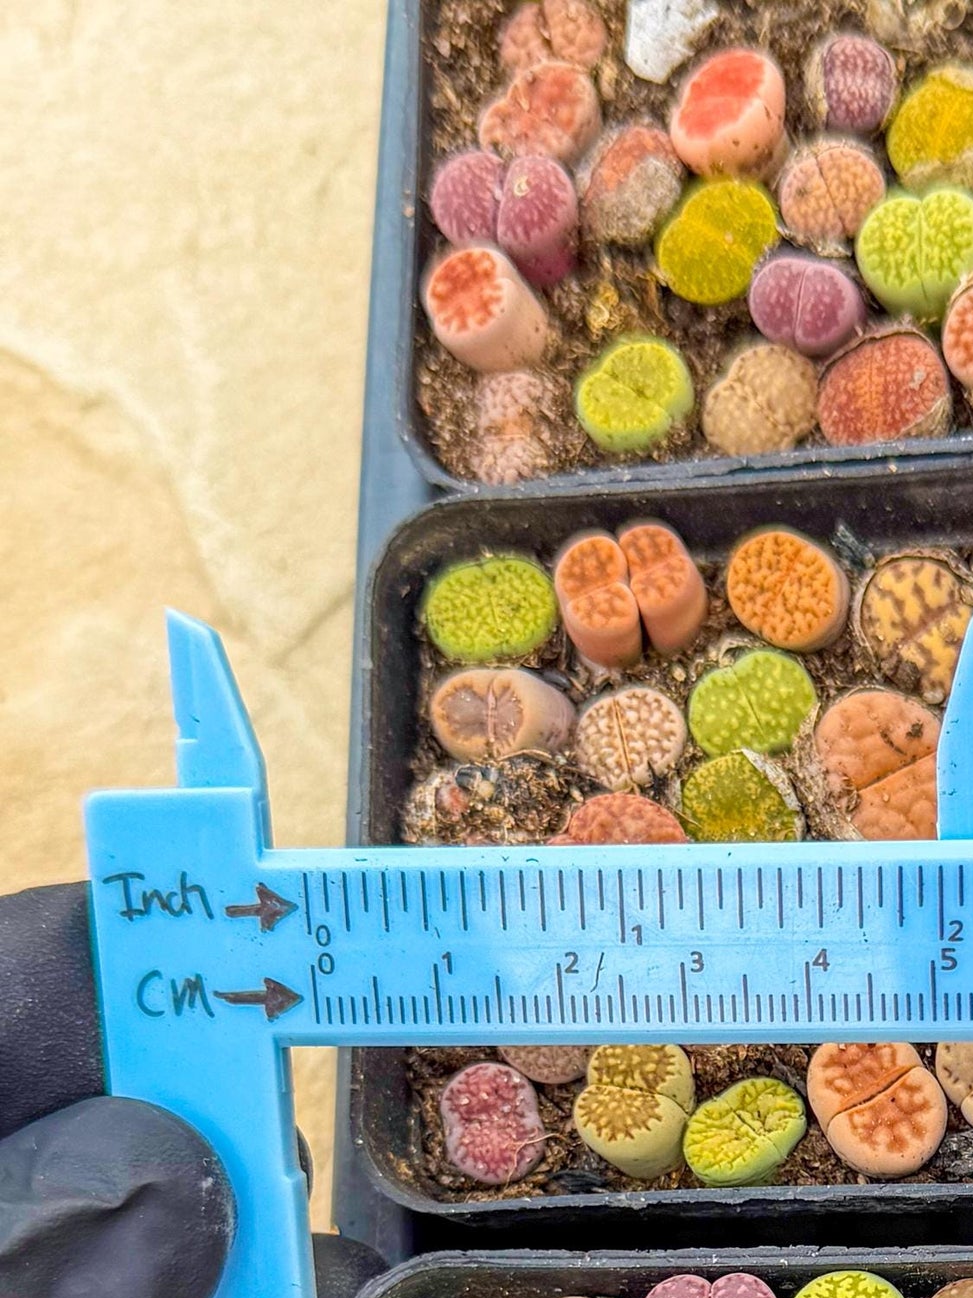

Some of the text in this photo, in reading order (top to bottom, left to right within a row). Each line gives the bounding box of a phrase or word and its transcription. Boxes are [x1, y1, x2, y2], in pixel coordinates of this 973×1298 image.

[102, 870, 214, 922] Inch
[315, 924, 332, 948] 0
[947, 920, 965, 943] 2
[317, 952, 336, 975] 0
[564, 951, 580, 974] 2
[689, 950, 705, 973] 3
[811, 948, 831, 972] 4
[940, 947, 958, 971] 5
